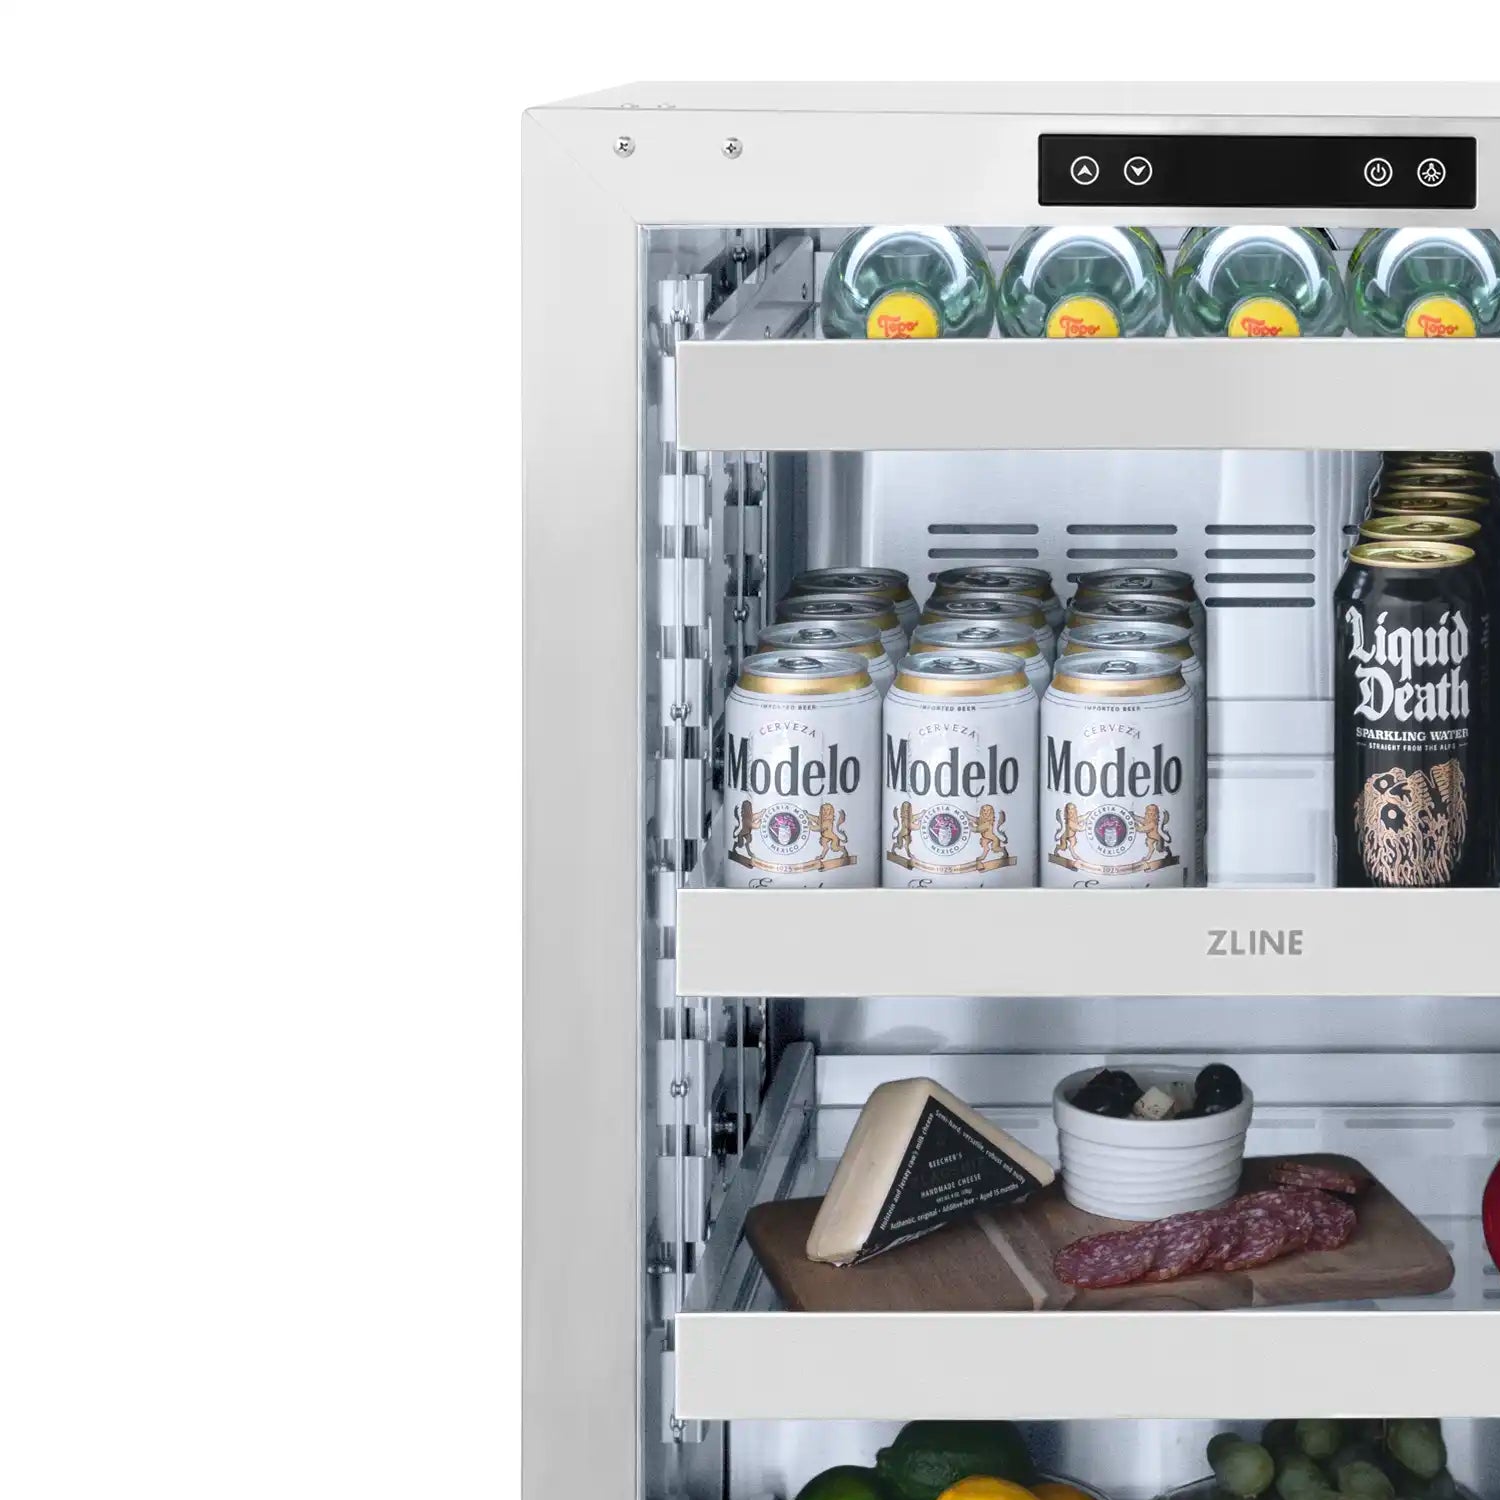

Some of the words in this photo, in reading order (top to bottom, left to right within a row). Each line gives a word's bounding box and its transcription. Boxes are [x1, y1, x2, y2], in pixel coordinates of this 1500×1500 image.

[877, 314, 920, 338] Topo
[1059, 315, 1101, 338] Topo
[1240, 316, 1283, 338] Topo
[1418, 315, 1459, 338] Topo
[1345, 604, 1469, 682] Liquid
[1353, 663, 1470, 722] Death
[759, 721, 817, 738] CERVEZA
[919, 723, 976, 738] CERVEZA
[1083, 723, 1142, 740] CERVEZA
[1355, 726, 1426, 741] SPARKLING
[1430, 728, 1469, 740] WATER
[1369, 742, 1400, 751] STRAIGHT
[727, 732, 860, 797] Modelo
[886, 733, 1019, 798] Modelo
[1046, 735, 1182, 798] Modelo
[1206, 929, 1304, 956] ZLINE
[928, 1151, 963, 1169] BEECHER'S
[879, 1204, 896, 1231] Holstein
[894, 1189, 902, 1203] and
[899, 1167, 911, 1190] Jersey
[916, 1135, 925, 1151] milk
[921, 1113, 934, 1136] cheese
[920, 1182, 956, 1199] HANDMADE
[957, 1173, 982, 1186] CHEESE
[979, 1191, 993, 1202] Aged
